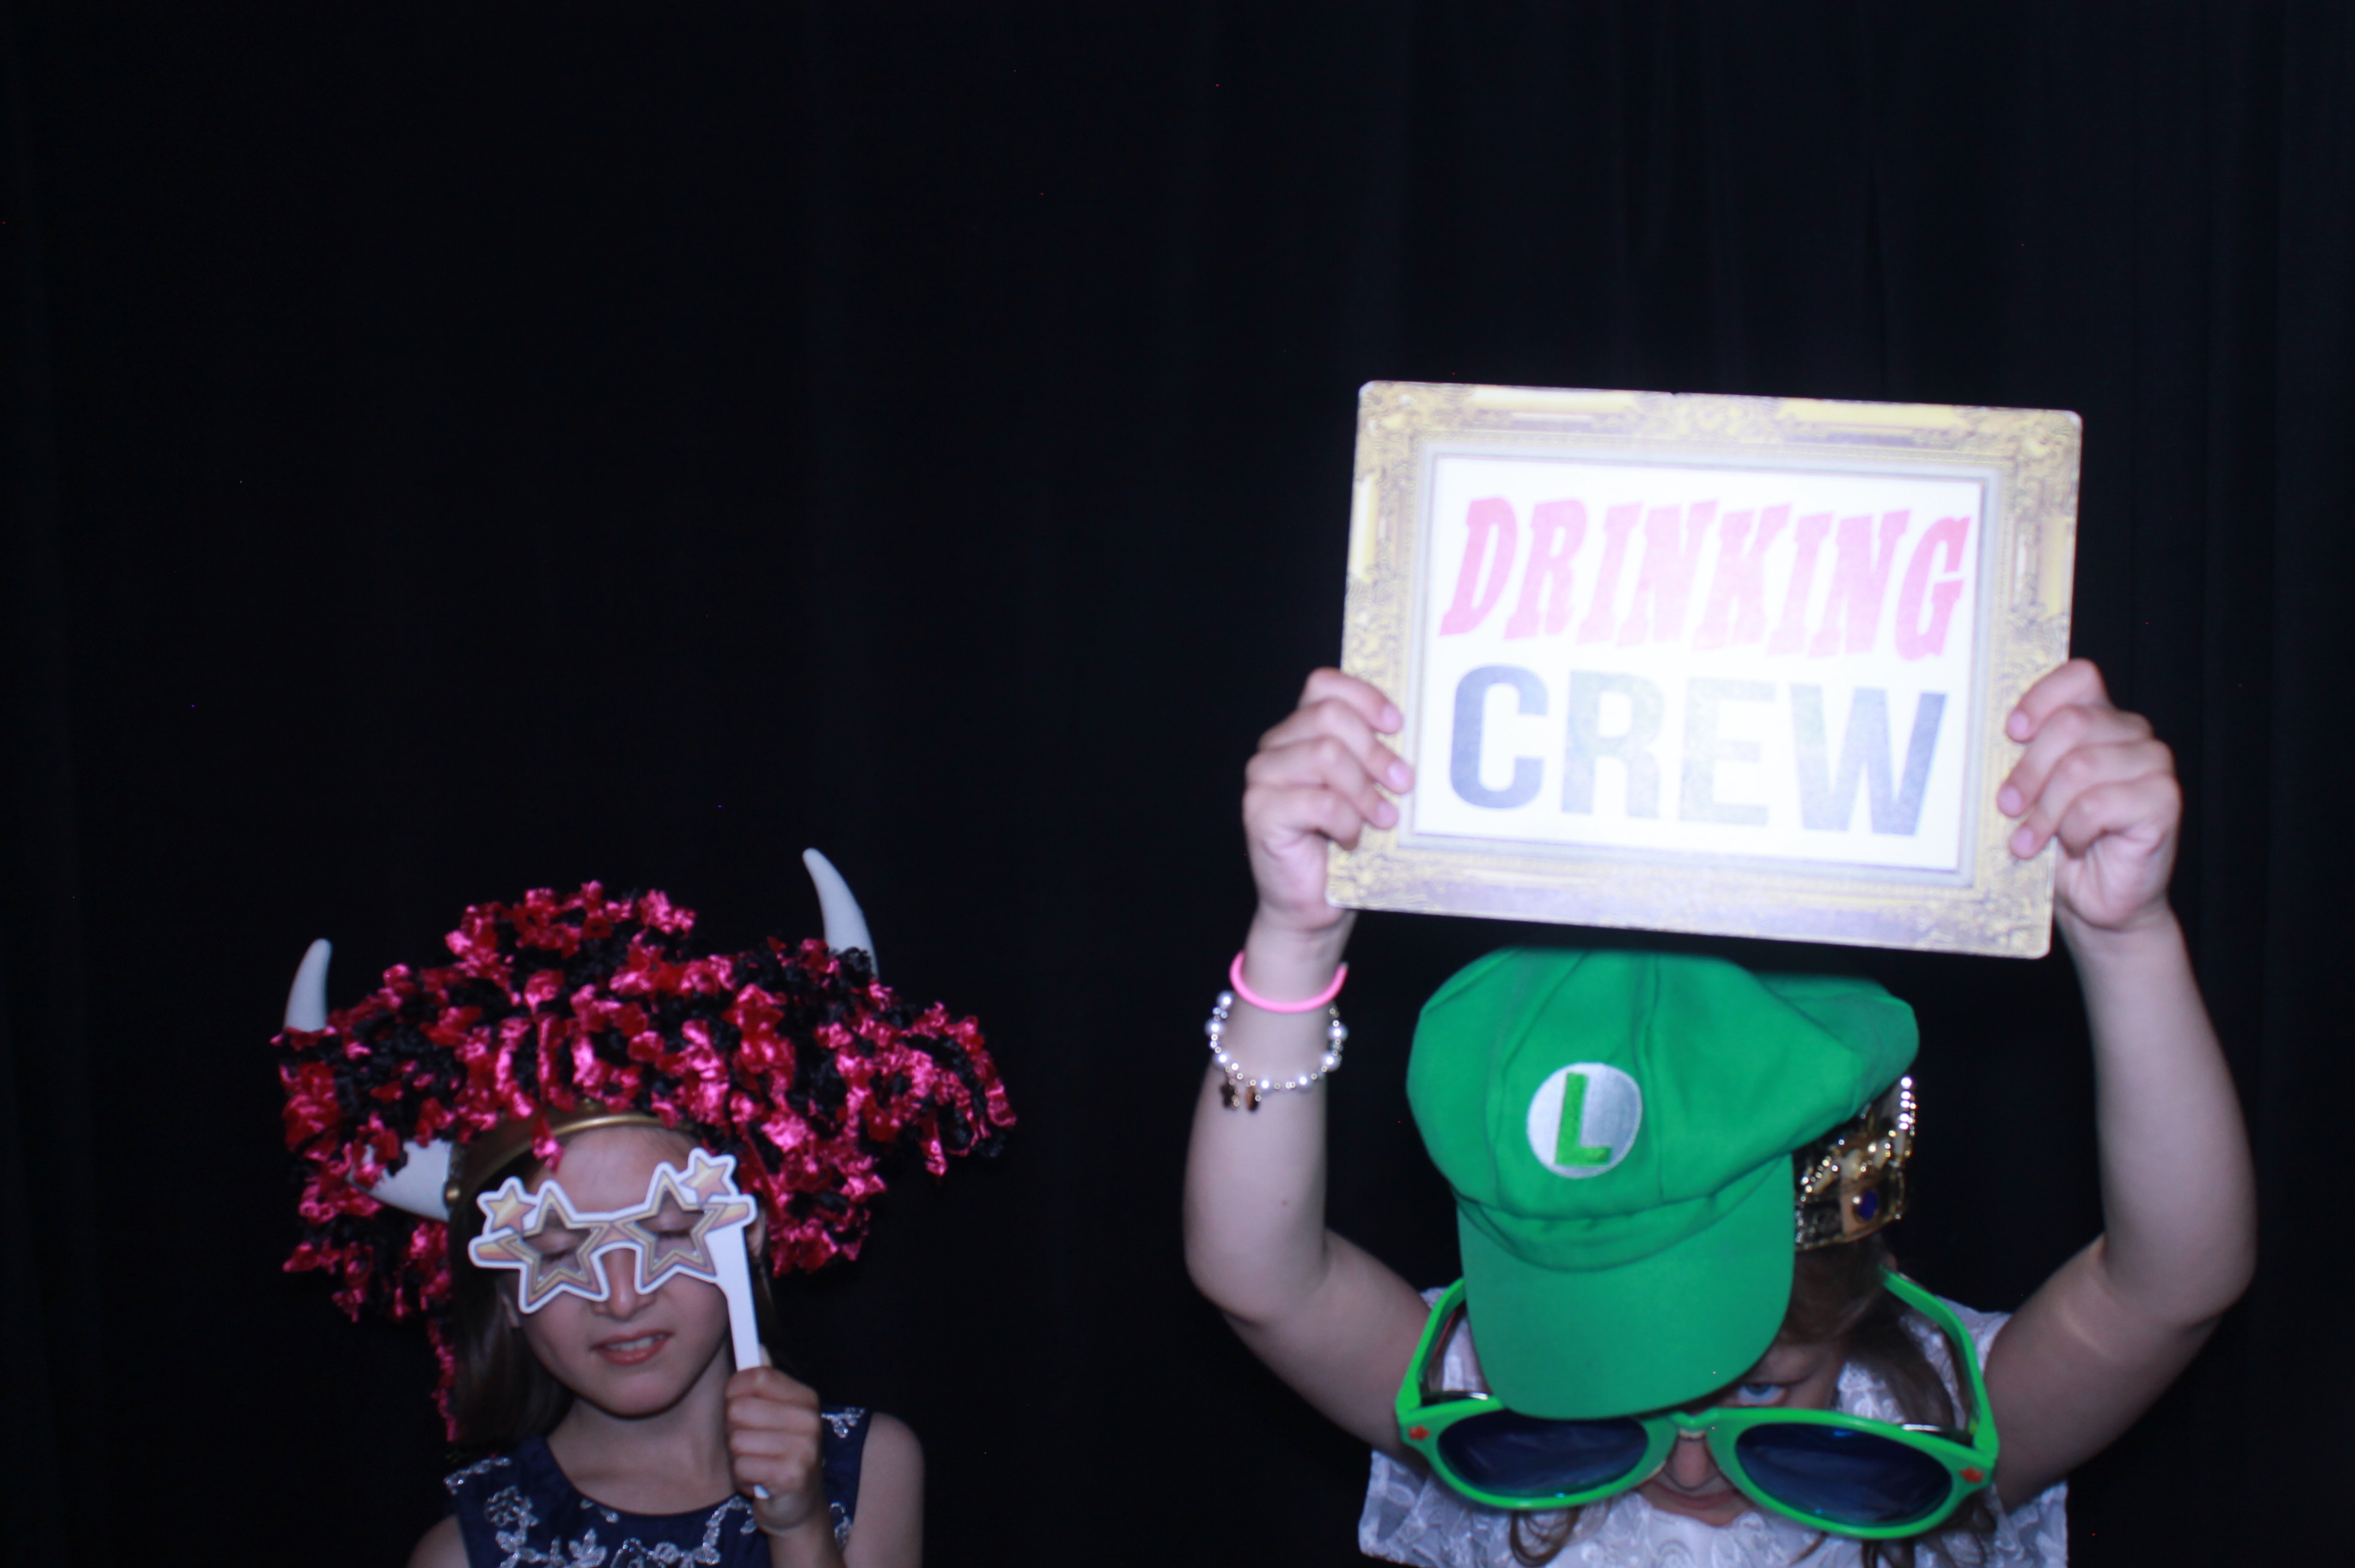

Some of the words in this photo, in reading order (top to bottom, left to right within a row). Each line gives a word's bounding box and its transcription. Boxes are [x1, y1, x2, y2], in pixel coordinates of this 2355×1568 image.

[1439, 496, 1971, 661] DRINKING
[1448, 664, 1948, 836] CREW
[1554, 1072, 1612, 1167] L
